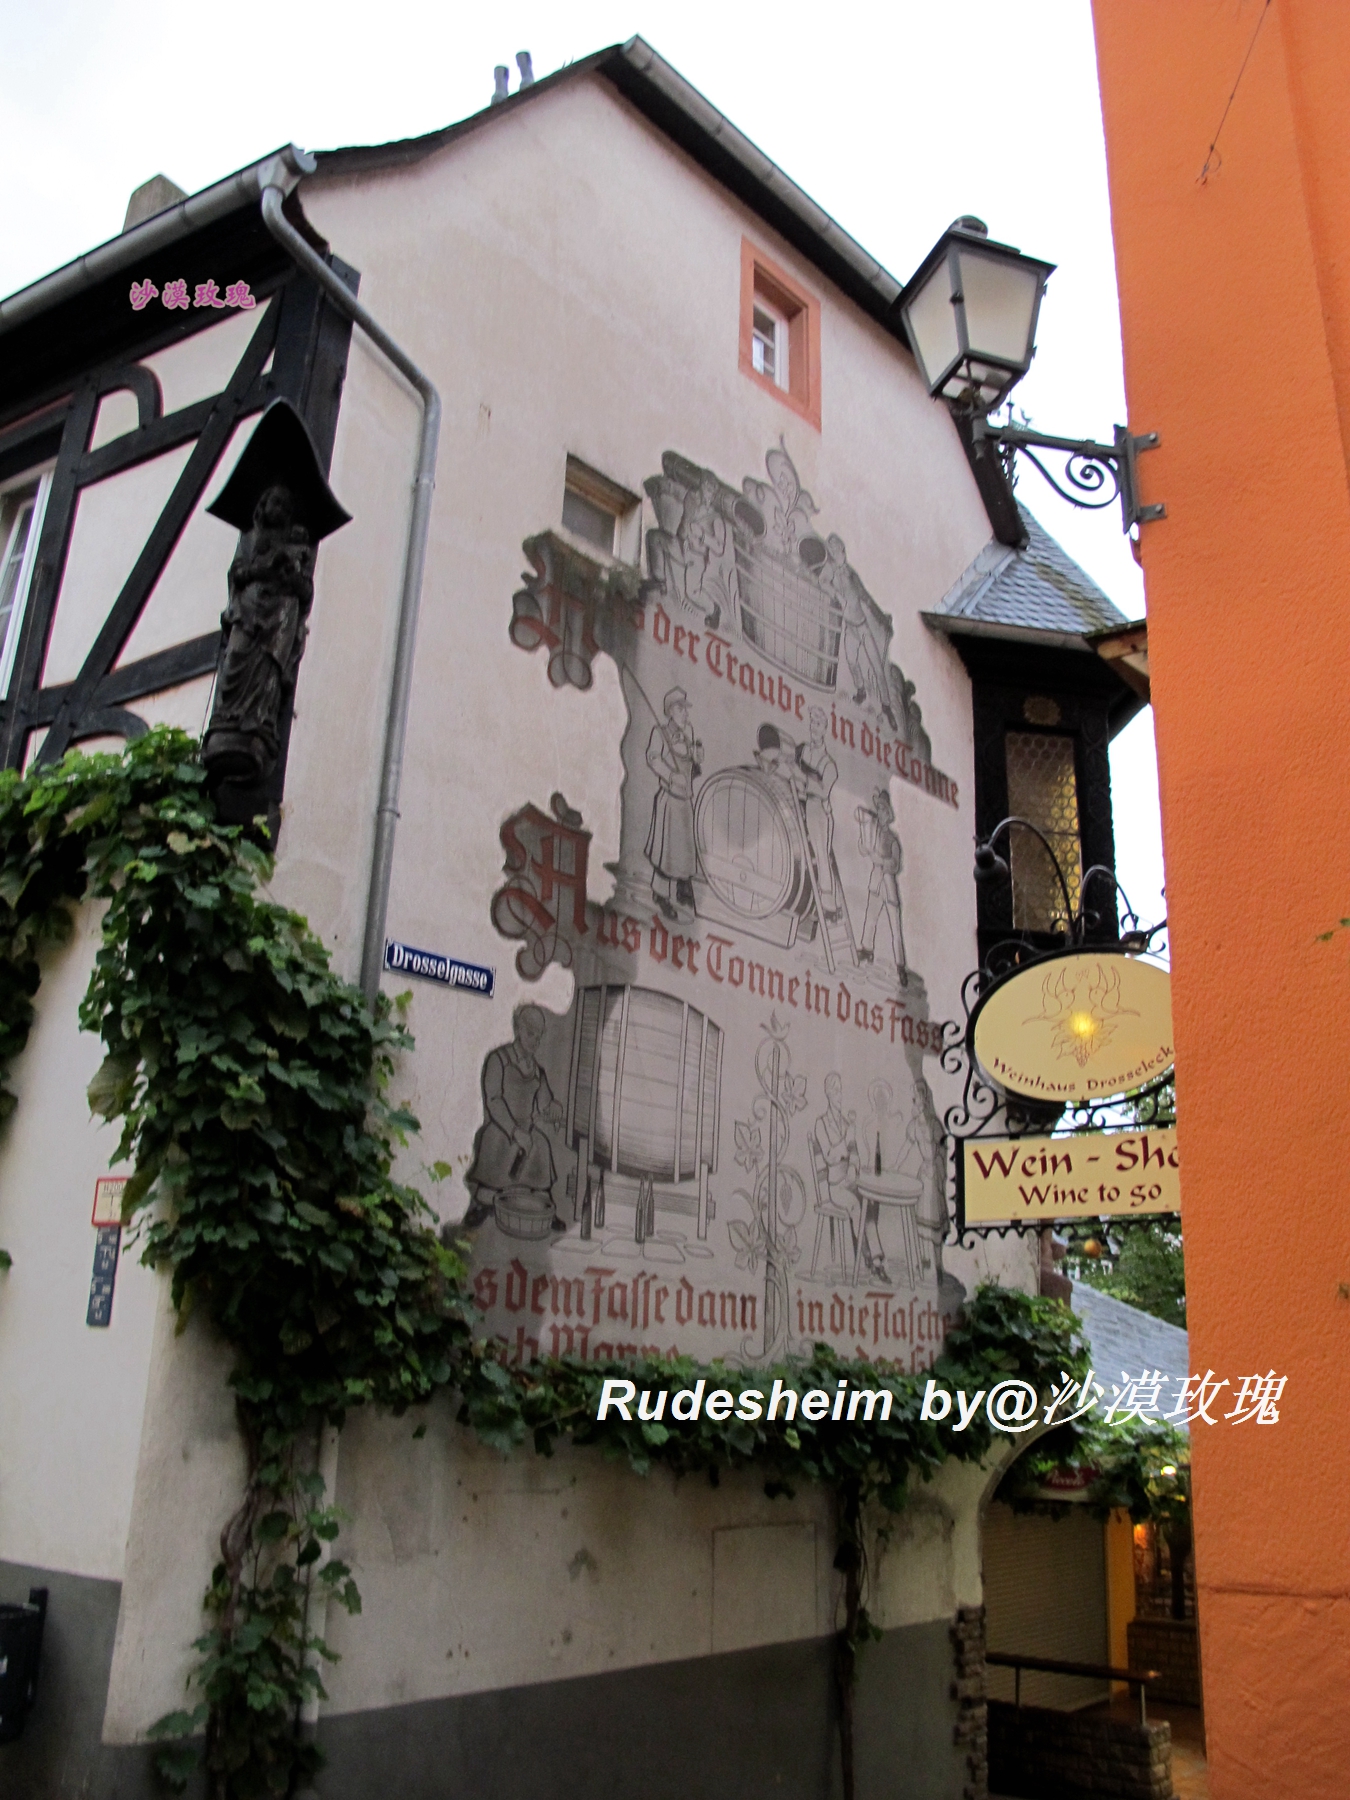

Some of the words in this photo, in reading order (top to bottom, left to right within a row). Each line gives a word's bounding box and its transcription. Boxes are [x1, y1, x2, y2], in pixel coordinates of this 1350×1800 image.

[653, 603, 701, 665] der
[704, 631, 806, 721] Traube
[830, 702, 856, 749] in
[861, 721, 892, 770] die
[894, 739, 960, 810] Tonne
[491, 800, 641, 978] Aus
[650, 914, 701, 976] der
[706, 933, 800, 1008] Tonne
[805, 969, 831, 1019] in
[836, 981, 884, 1035] das
[392, 944, 488, 991] Drosselgasse
[993, 1056, 1077, 1092] Weinhaus
[1086, 1044, 1174, 1091] Drosseleck
[972, 1144, 1073, 1180] Wein
[1114, 1134, 1180, 1172] Sho
[1018, 1183, 1089, 1207] Wine
[1098, 1182, 1121, 1203] to
[1129, 1183, 1163, 1208] go
[504, 1258, 585, 1317] dem
[675, 1275, 758, 1332] dann
[797, 1288, 825, 1335] in
[829, 1292, 870, 1340] die
